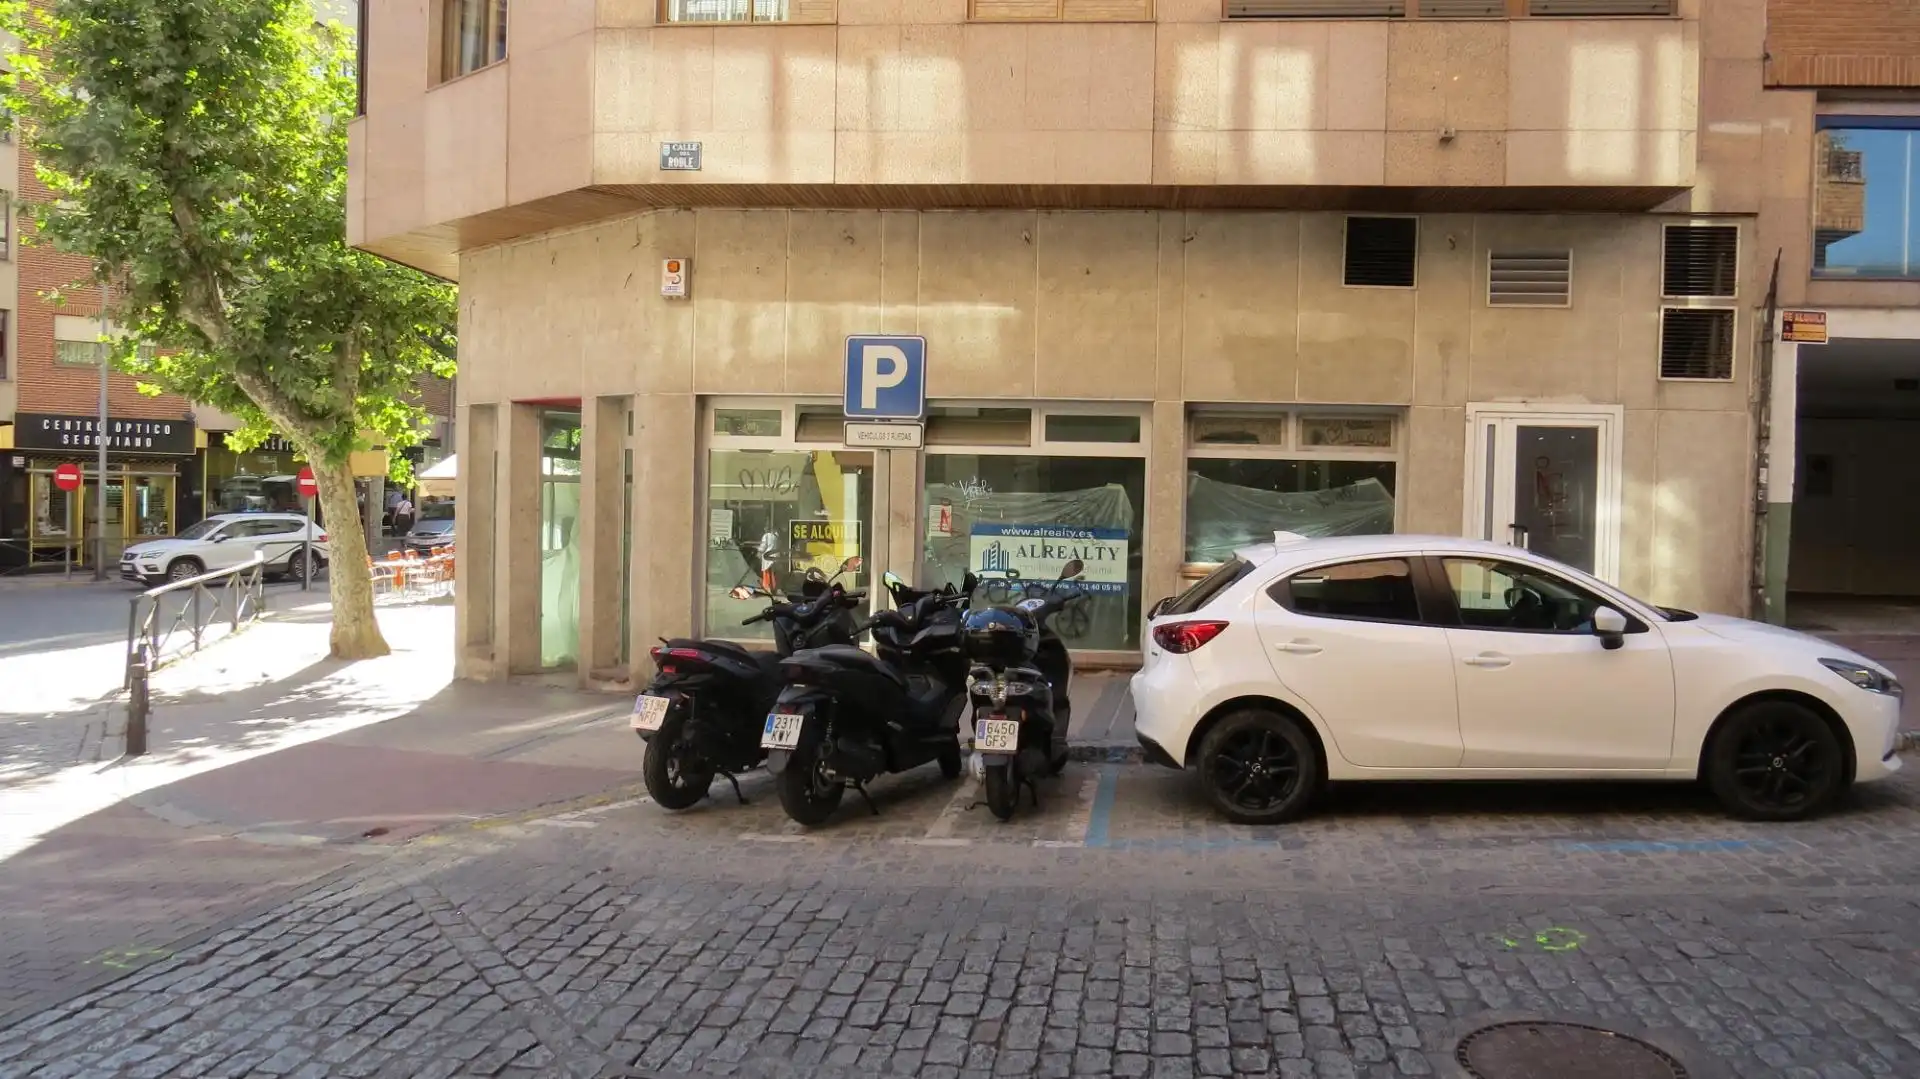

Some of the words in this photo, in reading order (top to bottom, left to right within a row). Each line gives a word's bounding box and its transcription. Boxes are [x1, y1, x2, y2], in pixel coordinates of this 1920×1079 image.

[672, 143, 698, 151] CALLE
[668, 156, 694, 168] ROBLE
[861, 345, 908, 409] P
[63, 434, 152, 448] SEGOVIANO
[793, 524, 808, 539] SE
[1001, 527, 1093, 539] www.alrealty.es
[1016, 544, 1120, 561] ALREALTY
[775, 717, 800, 730] 2311
[987, 722, 1016, 735] 6450
[985, 735, 1007, 748] GFS
